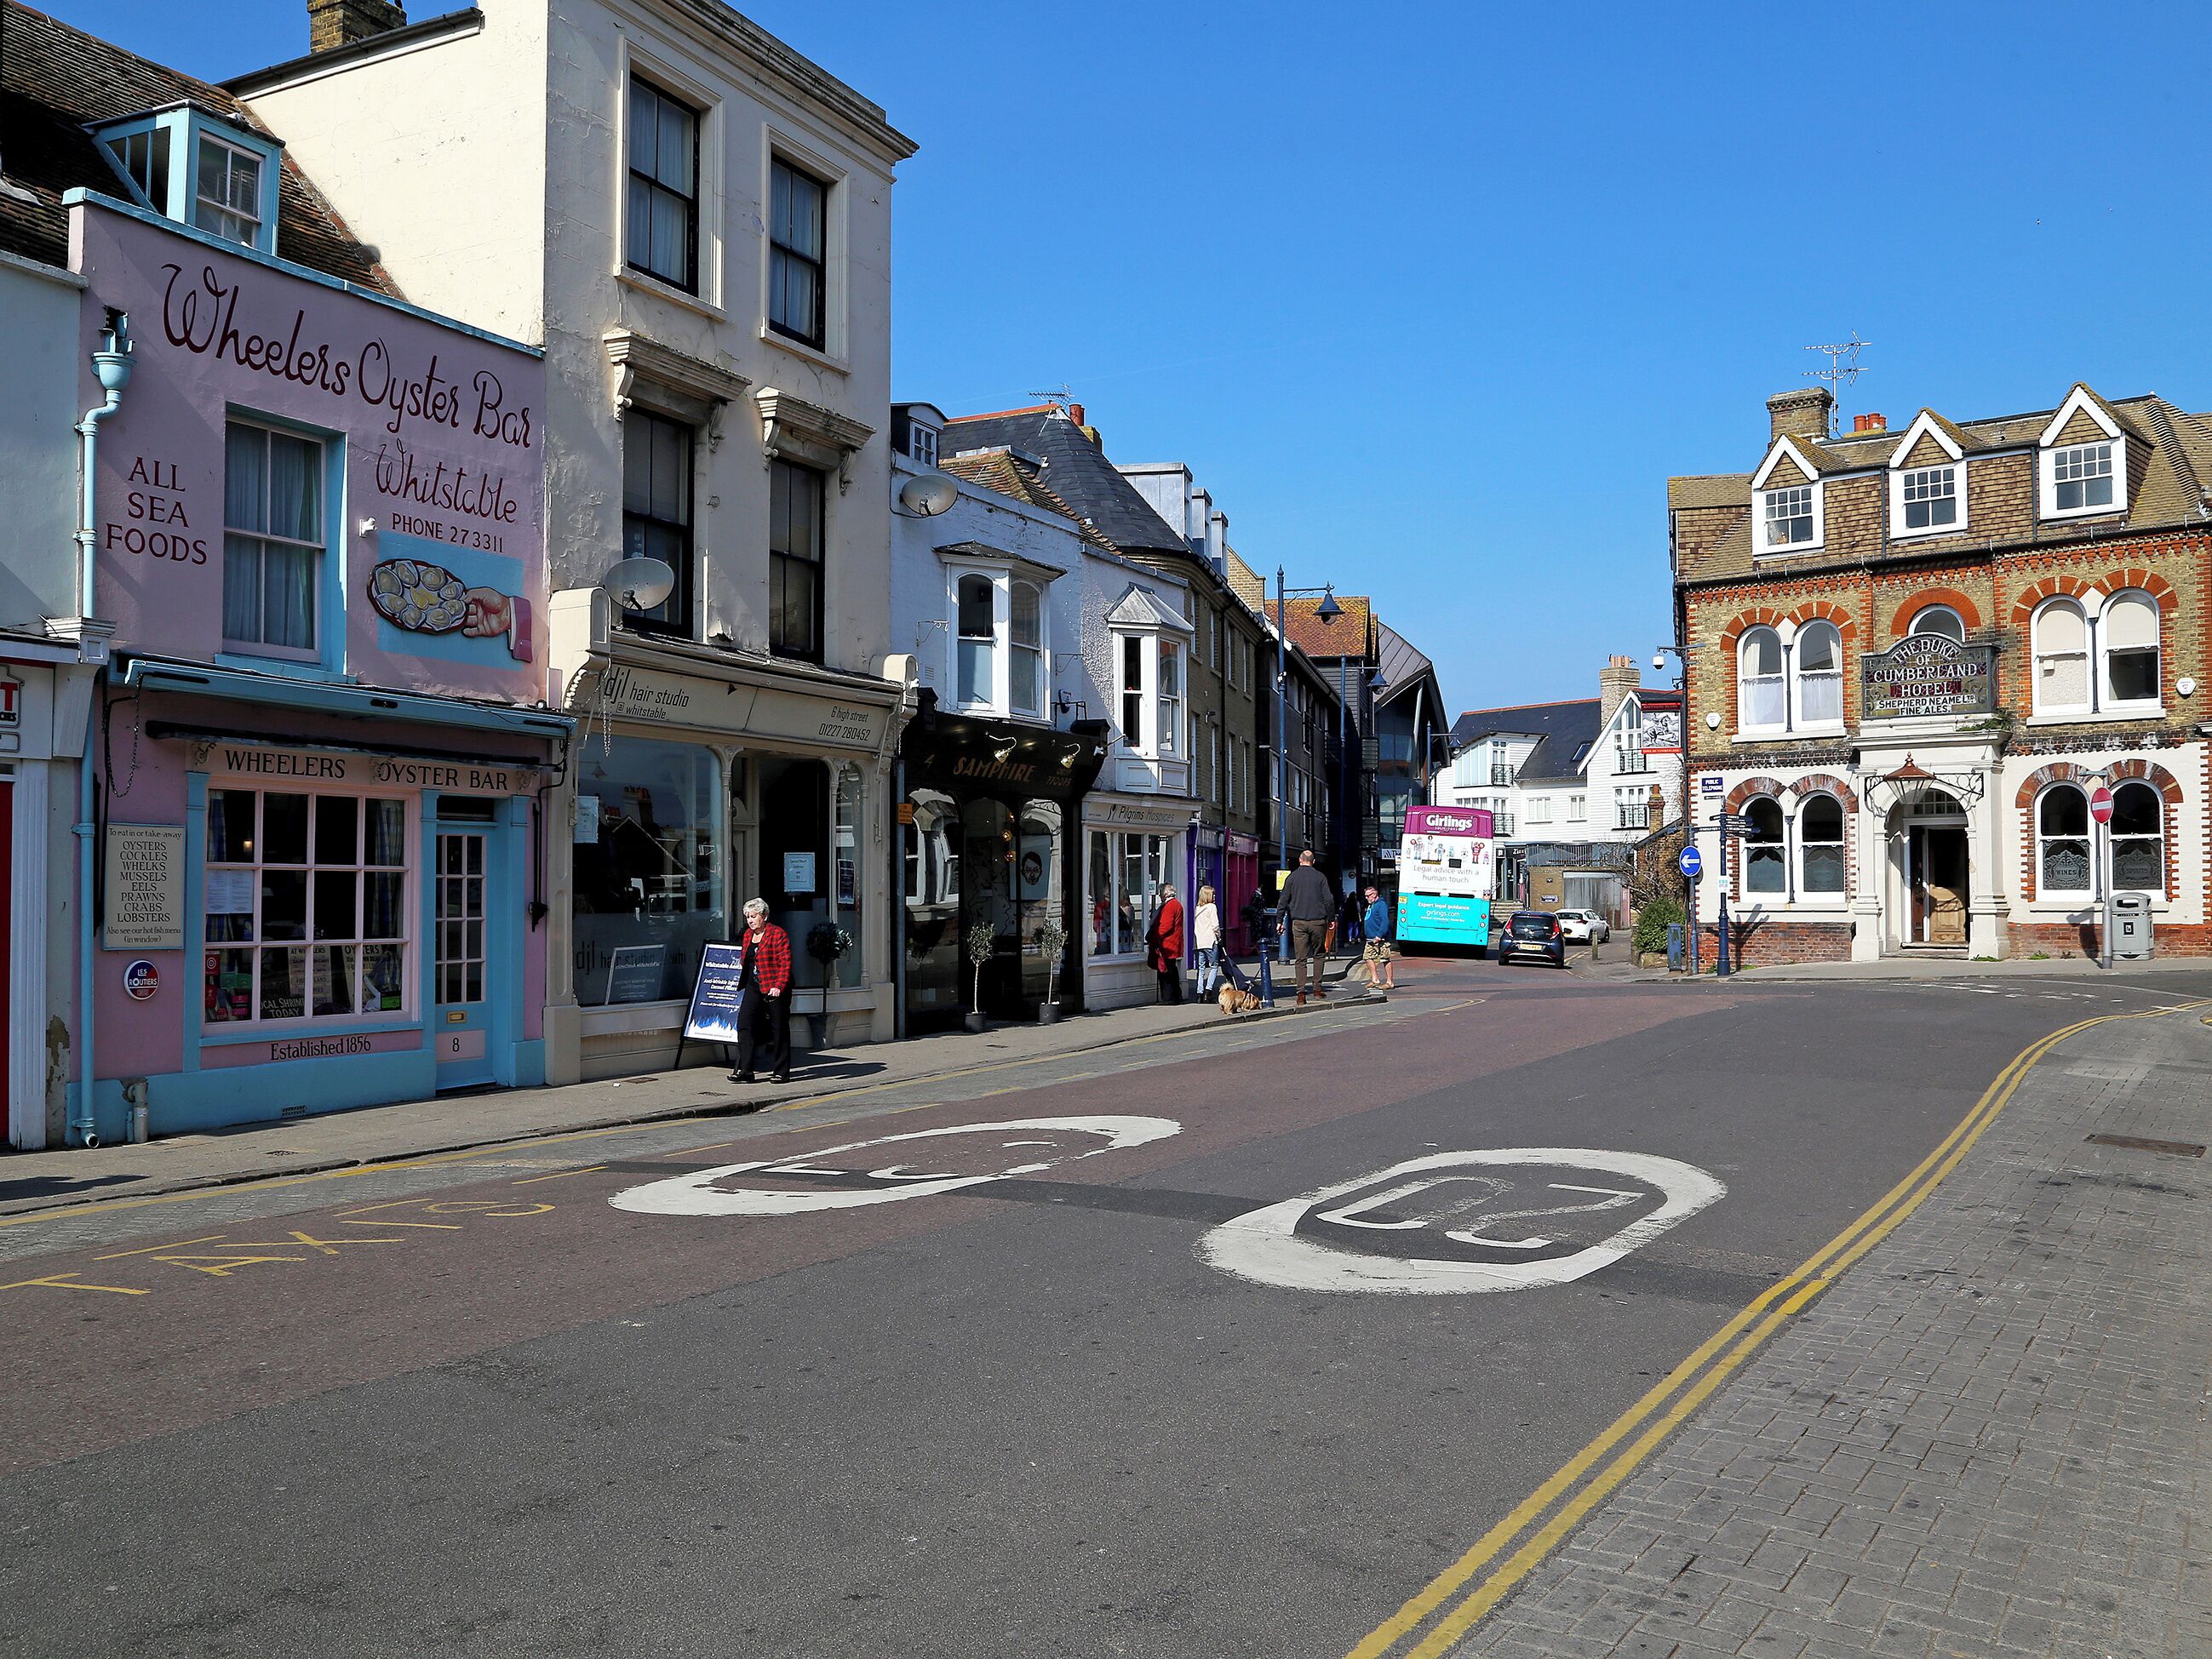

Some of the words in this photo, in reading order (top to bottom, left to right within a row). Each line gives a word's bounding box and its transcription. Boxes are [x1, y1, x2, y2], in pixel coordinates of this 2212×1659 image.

[161, 263, 350, 398] Wheelers
[358, 337, 460, 433] Oyster
[473, 370, 531, 449] Bar
[128, 456, 186, 492] ALL
[375, 438, 518, 524] Whitstable
[127, 493, 189, 528] SEA
[391, 512, 444, 541] PHONE
[105, 523, 208, 566] FOODS
[1891, 641, 1920, 664] THE
[1921, 638, 1962, 661] DUKE
[1917, 654, 1932, 666] OF
[1874, 663, 1977, 683] CUMBERLAND
[605, 666, 631, 704] djl
[630, 681, 652, 703] hair
[656, 686, 690, 708] studio
[1901, 681, 1952, 697] HOTEL
[1879, 699, 1927, 708] SHEPHERD
[1928, 695, 1961, 706] NEAME
[626, 706, 666, 720] whitstable
[831, 706, 835, 718] 6
[835, 707, 850, 721] high
[851, 710, 868, 723] street
[1900, 707, 1921, 715] FINE
[818, 724, 842, 738] 01227
[843, 725, 871, 741] 280452
[225, 750, 346, 779] WHEELERS
[379, 762, 459, 787] OYSTER
[469, 769, 508, 791] BAR
[953, 757, 1036, 782] SAMPHIRE
[1118, 805, 1144, 823] Pilgrims
[1145, 808, 1174, 823] Hospices
[1426, 814, 1473, 831] Girlings
[108, 827, 117, 836] To
[123, 841, 166, 851] OYSTERS
[120, 851, 168, 861] COCKLES
[122, 861, 166, 872] WHELKS
[1413, 865, 1432, 873] Legal
[119, 872, 167, 882] MUSSELS
[131, 882, 157, 892] EELS
[121, 892, 165, 902] PRAWNS
[123, 902, 163, 912] CRABS
[117, 912, 170, 923] LOBSTERS
[270, 1009, 299, 1018] TODAY
[270, 1035, 343, 1061] Established
[347, 1035, 371, 1054] 1856
[452, 1037, 461, 1052] 8
